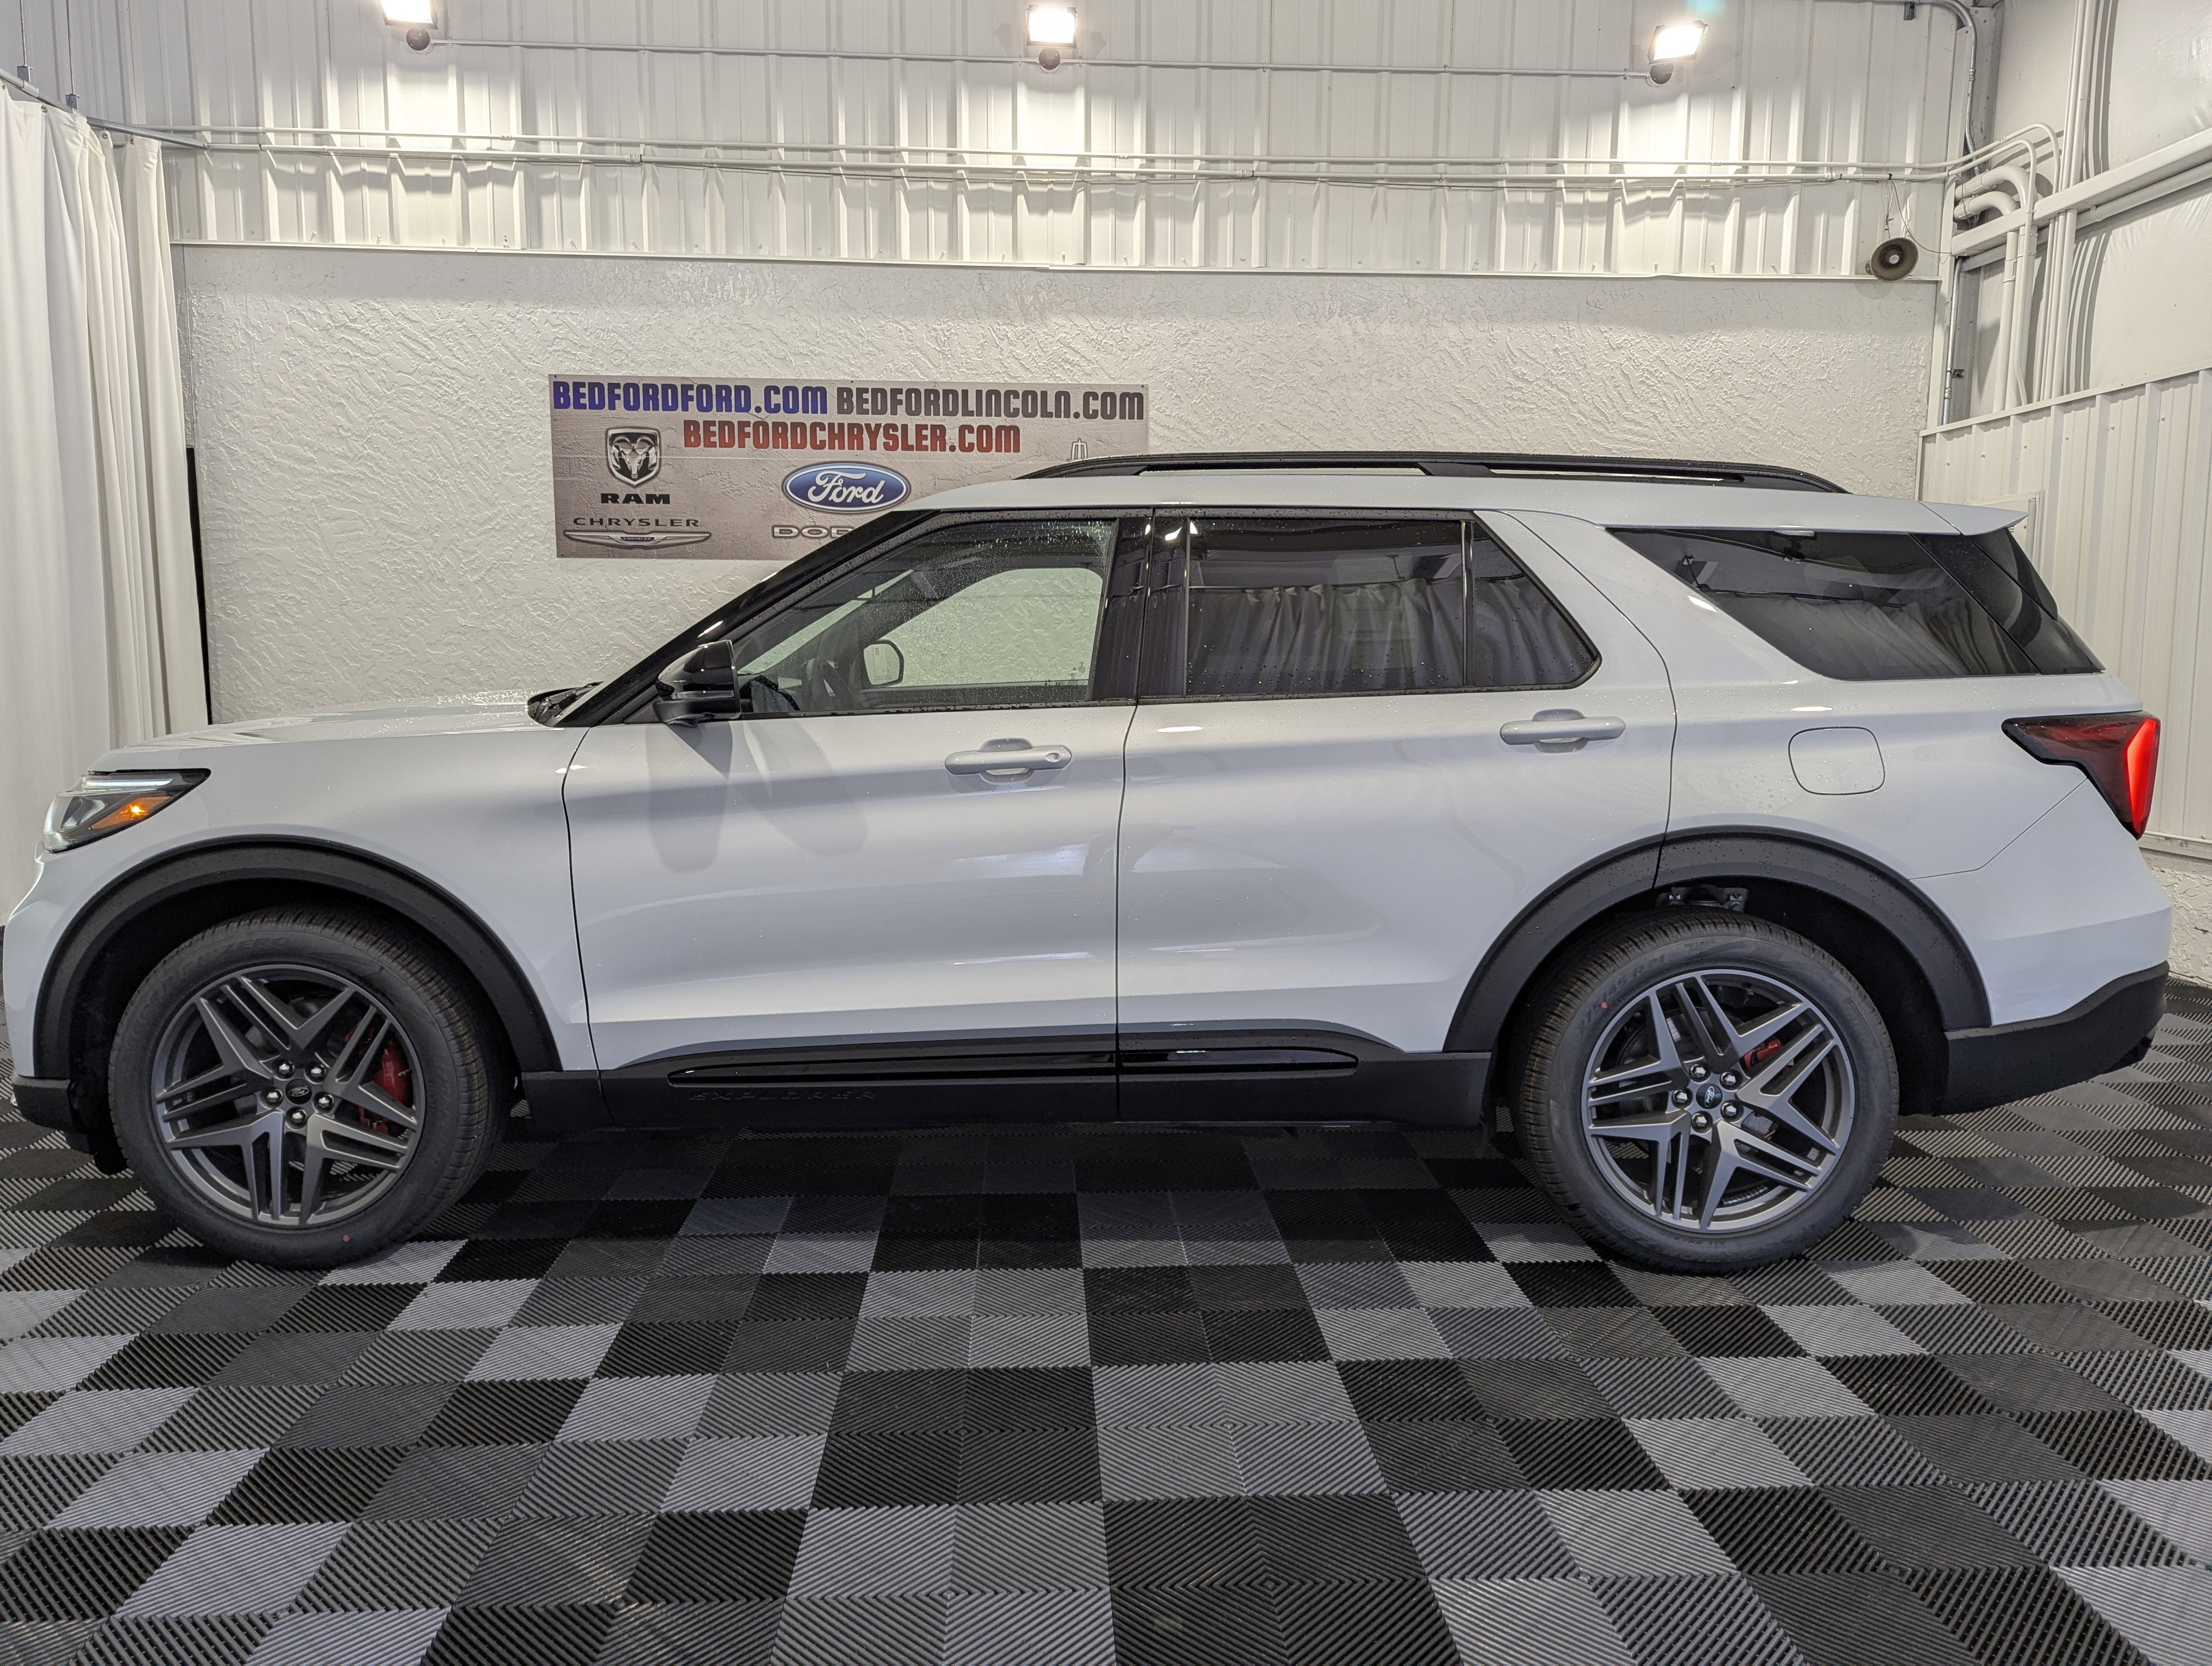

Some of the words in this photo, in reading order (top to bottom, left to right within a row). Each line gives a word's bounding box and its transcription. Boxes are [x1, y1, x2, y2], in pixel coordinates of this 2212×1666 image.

[552, 381, 827, 414] BEDFORDFORD.COM
[836, 387, 1144, 421] BEDFORDLINCOLN.COM
[683, 420, 1020, 453] BEDFORDCHRYSLER.COM
[807, 470, 886, 503] Ford
[600, 492, 670, 504] RAM
[573, 517, 699, 527] CHRYSLER
[772, 525, 855, 538] DOD
[1706, 1088, 1714, 1105] Ford
